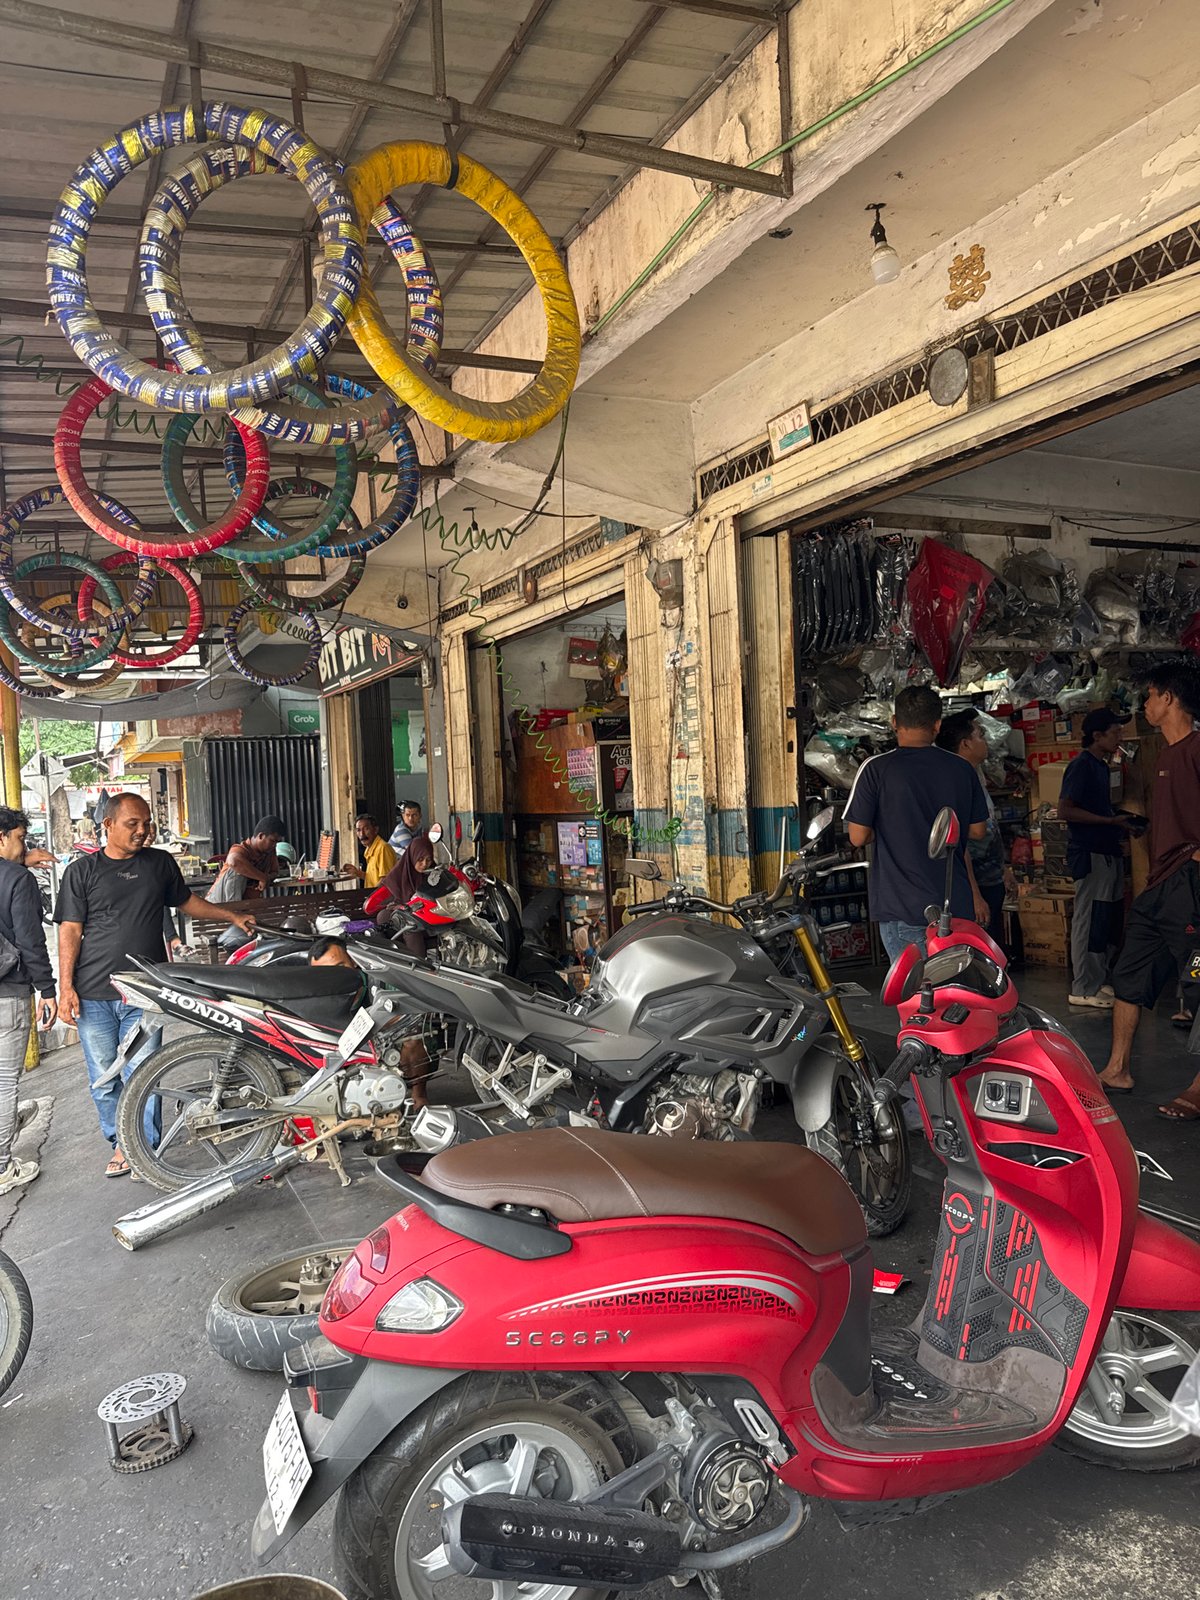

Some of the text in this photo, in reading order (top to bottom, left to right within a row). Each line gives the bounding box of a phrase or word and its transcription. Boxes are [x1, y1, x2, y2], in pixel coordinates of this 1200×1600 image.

[327, 272, 356, 294] YAMAHA
[410, 323, 439, 341] YAMAHA
[301, 328, 326, 361] YAMAHA
[791, 413, 804, 430] 12
[339, 627, 367, 672] BIT
[293, 714, 315, 724] Grab
[1192, 956, 1200, 967] B
[158, 986, 244, 1033] HONDA
[944, 1203, 976, 1223] SCOOPY
[505, 1330, 632, 1347] SCOOPY
[871, 1354, 928, 1399] COOPY
[531, 1525, 619, 1548] HONDA
